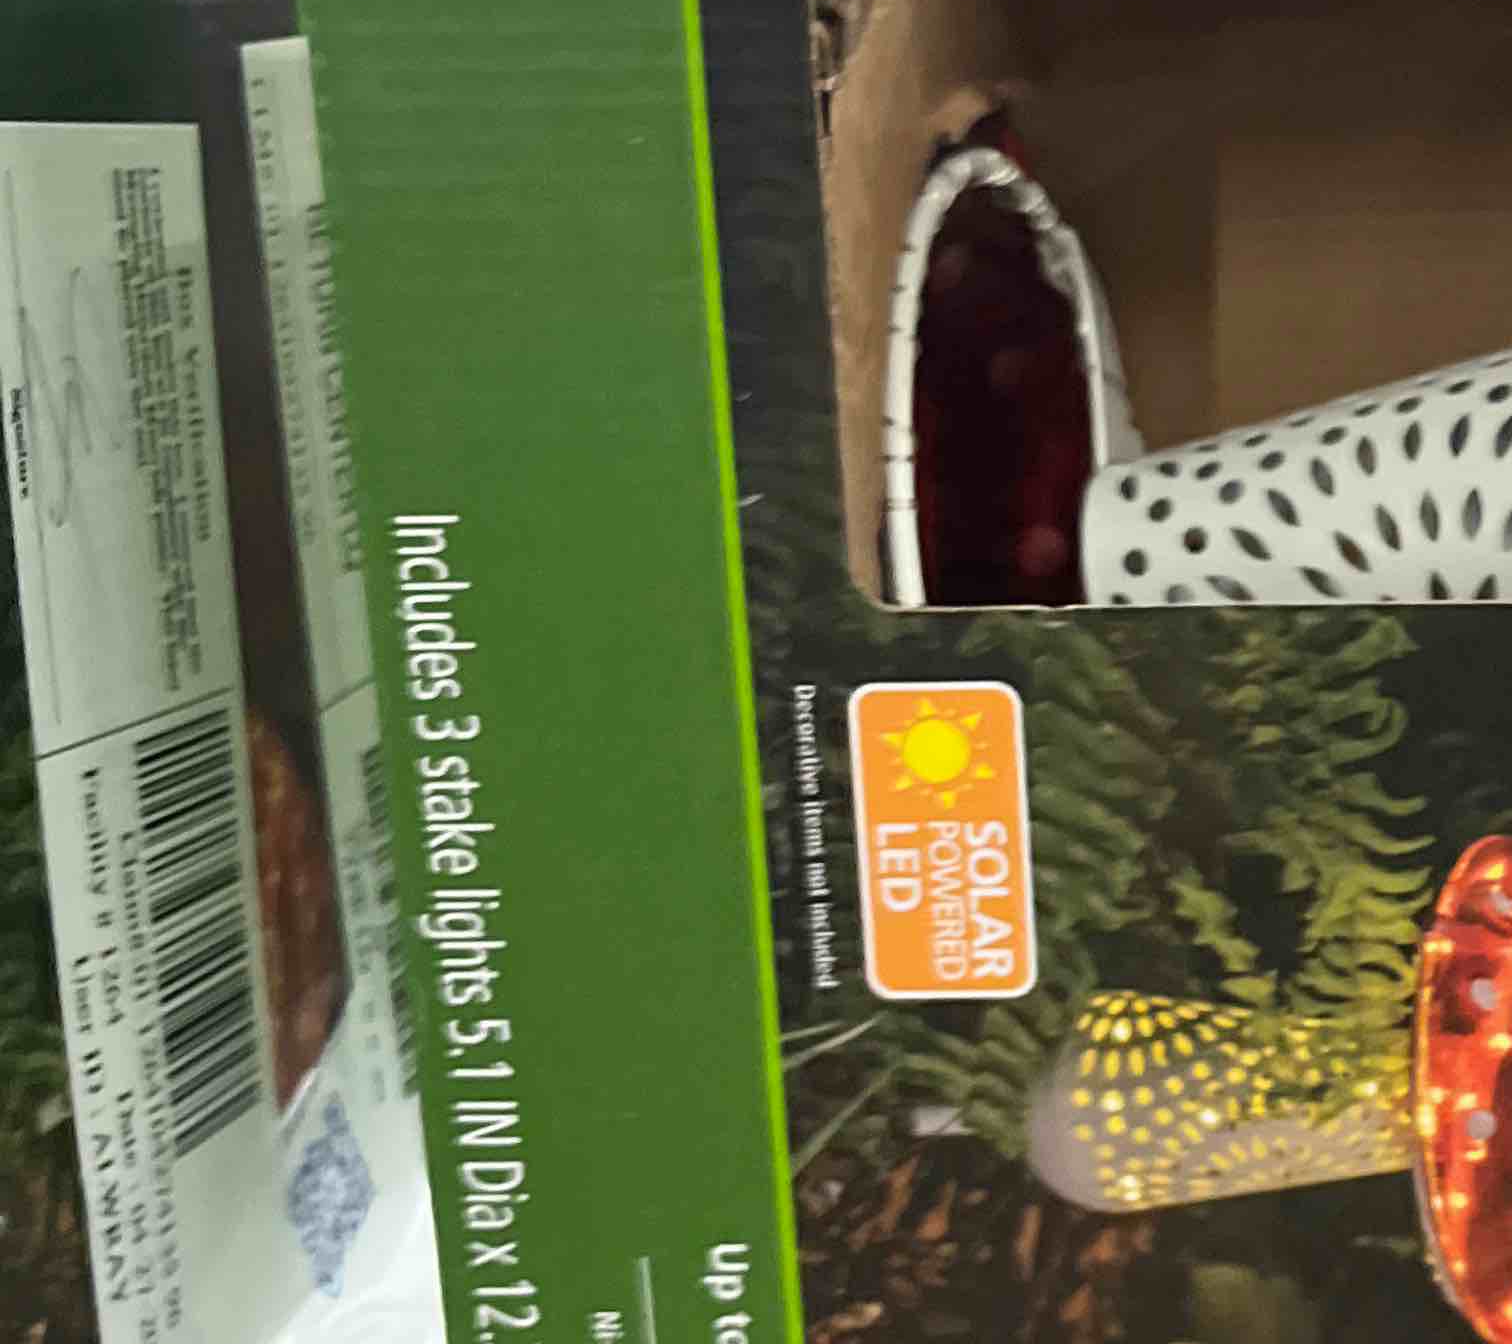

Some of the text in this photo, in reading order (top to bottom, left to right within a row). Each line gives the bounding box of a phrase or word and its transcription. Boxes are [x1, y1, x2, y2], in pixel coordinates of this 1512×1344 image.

[394, 515, 476, 700] Includes
[414, 715, 480, 740] 3
[81, 766, 112, 896] Facility
[420, 756, 494, 874] stake
[794, 685, 840, 987] Decorative items not included
[876, 824, 921, 912] LED
[927, 821, 966, 981] POWERED
[965, 821, 1015, 977] SOLAR
[417, 890, 506, 1005] lights
[71, 955, 97, 1035] User
[448, 1020, 514, 1077] 5.1
[454, 1102, 521, 1146] IN
[461, 1161, 528, 1229] Dia
[470, 1243, 517, 1265] x
[703, 1244, 749, 1300] Up
